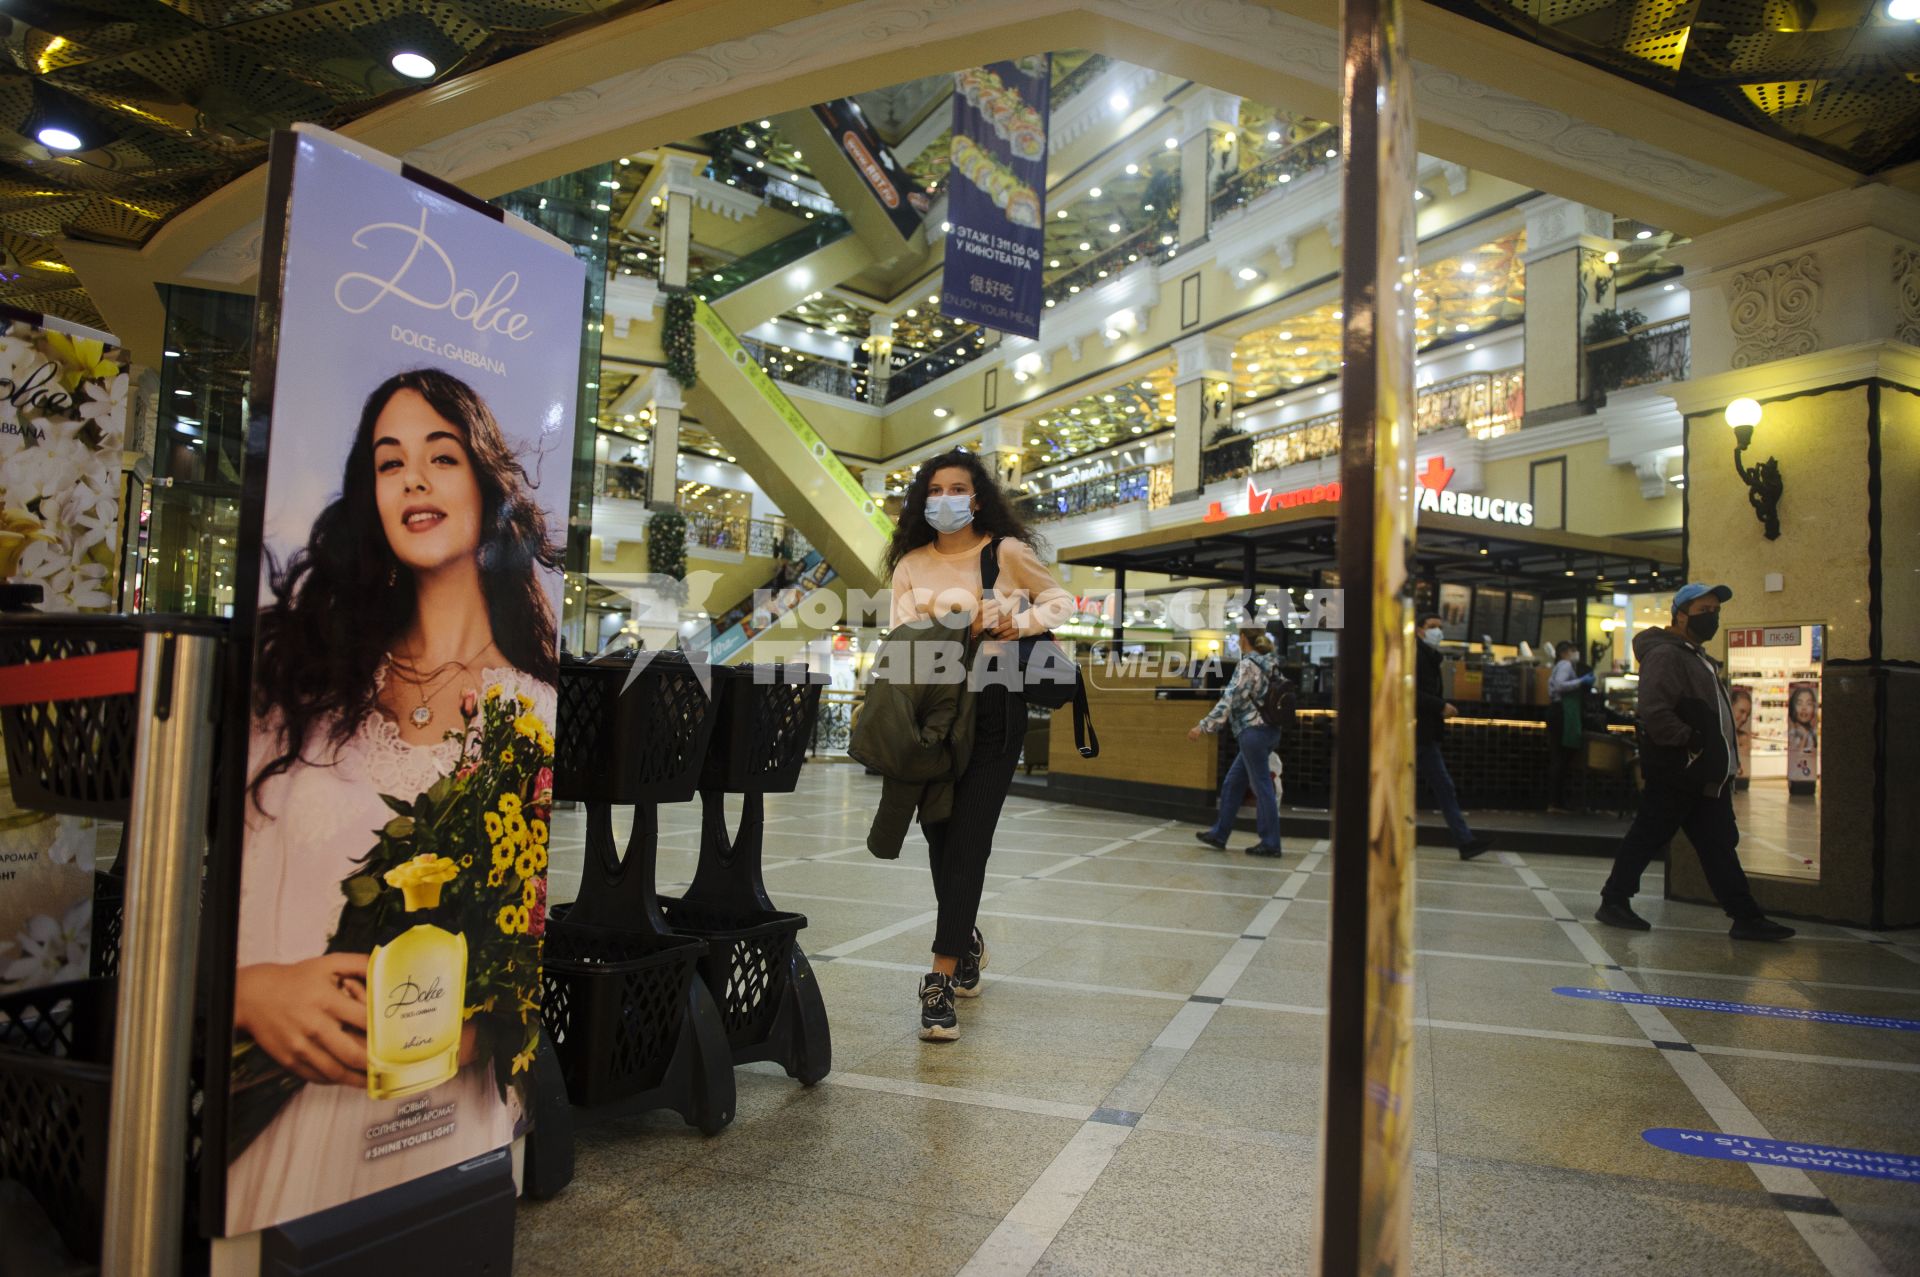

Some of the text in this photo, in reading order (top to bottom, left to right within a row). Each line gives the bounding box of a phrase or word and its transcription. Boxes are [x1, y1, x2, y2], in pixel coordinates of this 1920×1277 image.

[955, 238, 1031, 270] У КИНОТЕАТРА
[957, 226, 989, 244] ЭТАЖ
[997, 237, 1011, 251] 311
[1011, 242, 1026, 256] 06
[1026, 247, 1040, 260] 06
[334, 208, 533, 341] Dolce
[943, 292, 1037, 327] ENJOY YOUR MEAL
[391, 325, 436, 353] DOLCE
[444, 343, 507, 377] GABBANA
[0, 422, 46, 441] BBANA
[1770, 631, 1794, 641] ПК-96
[384, 974, 446, 1019] Dolce
[402, 1035, 433, 1050] shine
[366, 1103, 455, 1139] СОЛНЕЧНЫЙ АРОМАТ
[398, 1096, 432, 1115] НОВЫЙ
[365, 1122, 456, 1160] #SHINEYOURLIGHT
[1714, 1138, 1757, 1149] 1,5
